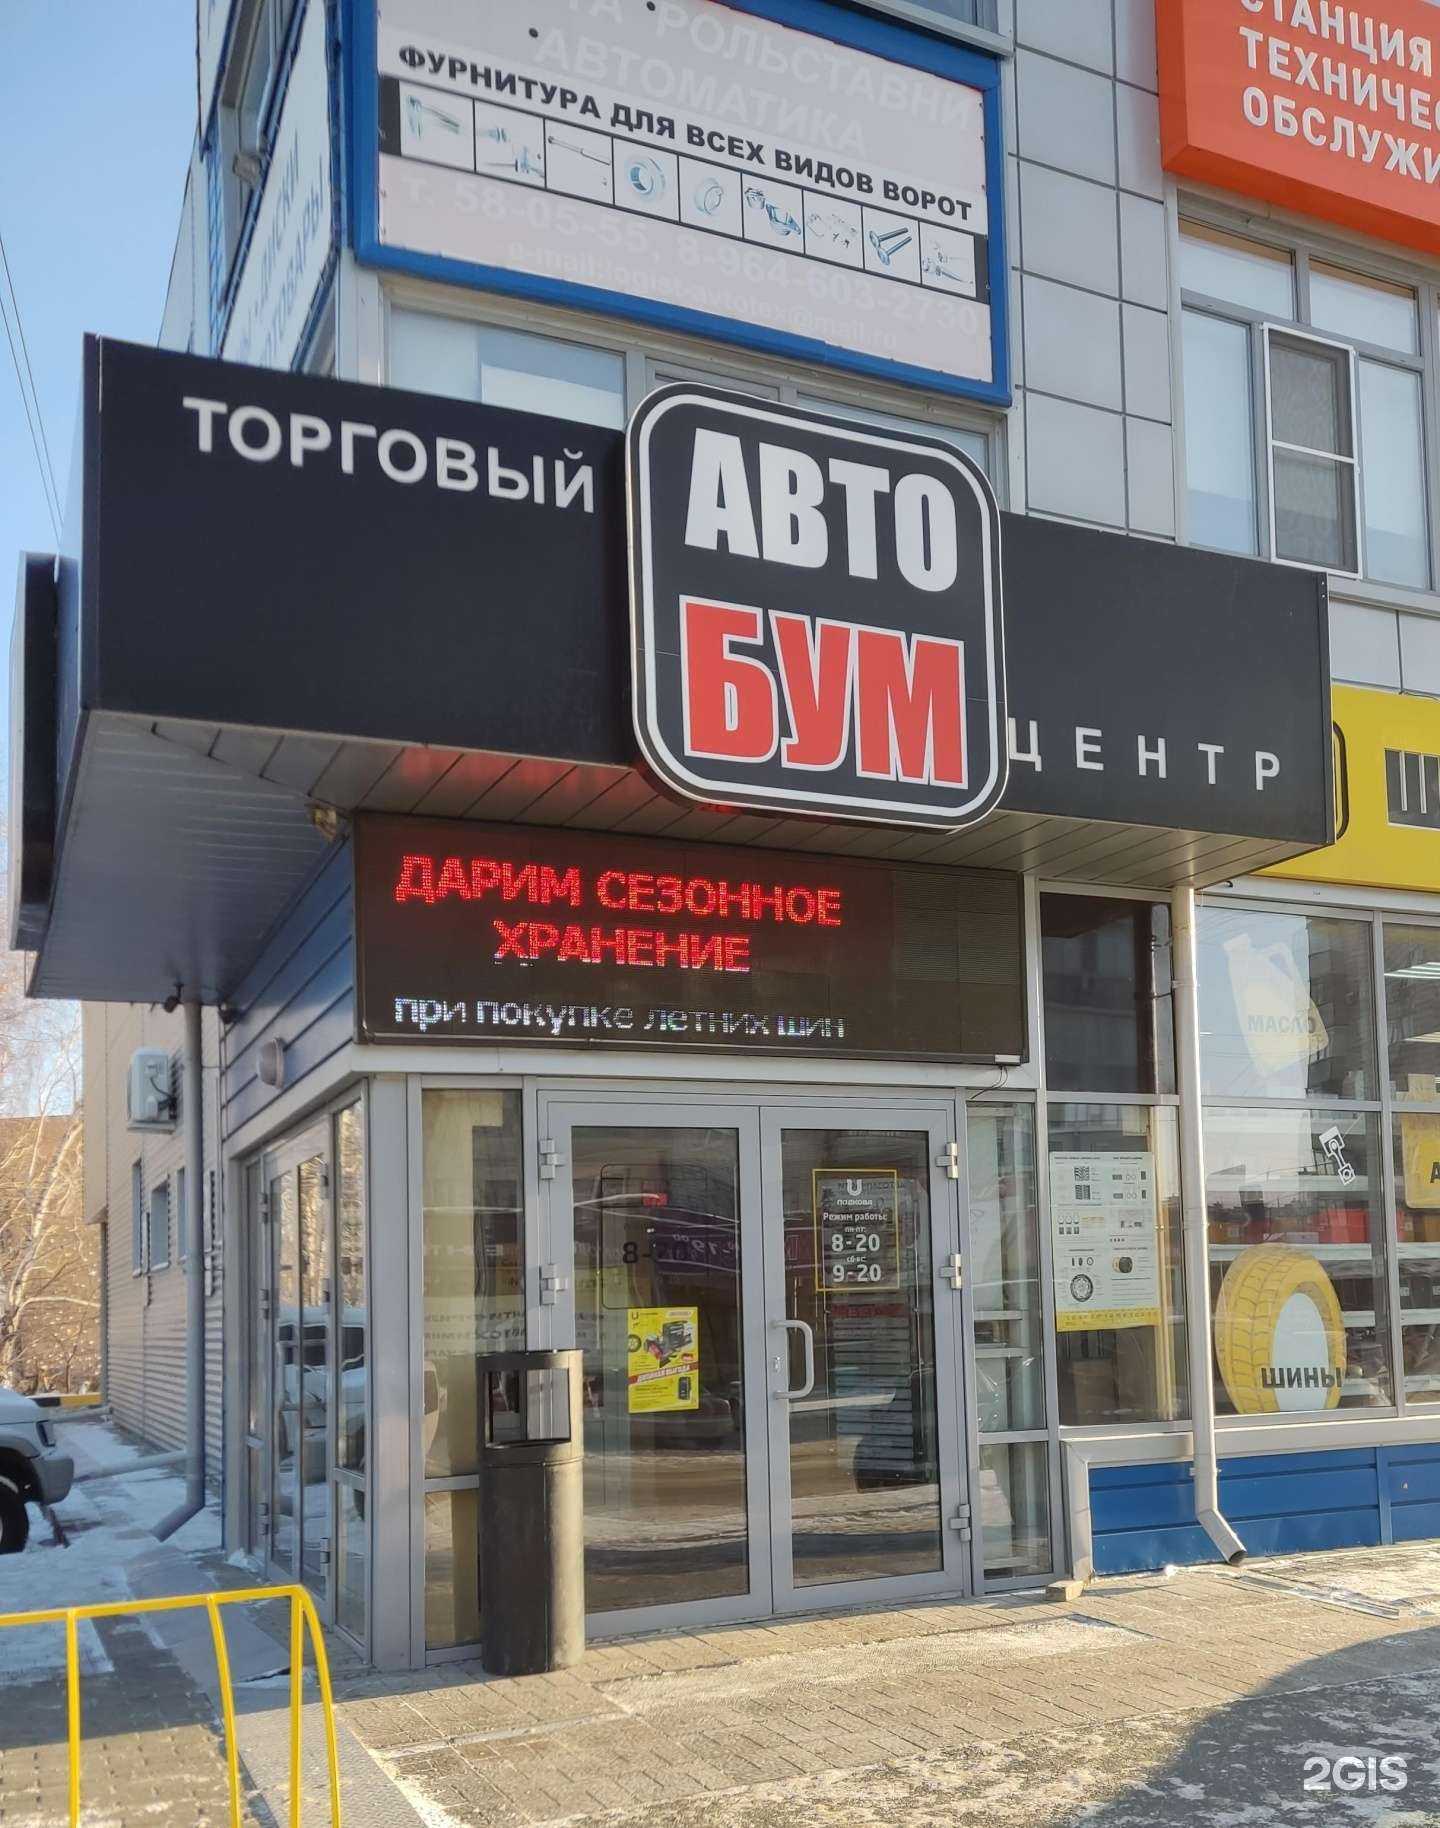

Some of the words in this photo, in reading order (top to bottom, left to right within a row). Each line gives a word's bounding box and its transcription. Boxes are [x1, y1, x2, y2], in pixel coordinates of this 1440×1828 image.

[534, 26, 870, 154] АВТОМАТИКА
[399, 44, 602, 119] ФУРНИТУРА
[610, 102, 676, 139] ДЛЯ
[686, 123, 767, 165] ВСЕХ
[775, 147, 874, 196] ВИДОВ
[884, 179, 972, 221] ВОРОТ
[183, 396, 595, 513] ТОРГОВЫЙ
[684, 427, 958, 593] АВТО
[679, 594, 969, 790] БУМ
[1008, 717, 1280, 791] ЦЕНТР
[395, 855, 582, 906] ДАРИМ
[597, 870, 842, 926] СЕЗОННОЕ
[493, 919, 750, 971] ХРАНЕНИЕ
[477, 1000, 633, 1036] покупке
[643, 1009, 770, 1035] летних
[777, 1014, 845, 1038] шин
[1248, 1014, 1316, 1034] МАСЛО
[823, 1212, 853, 1221] Режим
[831, 1233, 880, 1252] 8-20
[833, 1263, 882, 1283] 9-20
[1261, 1367, 1343, 1388] ШИНЫ
